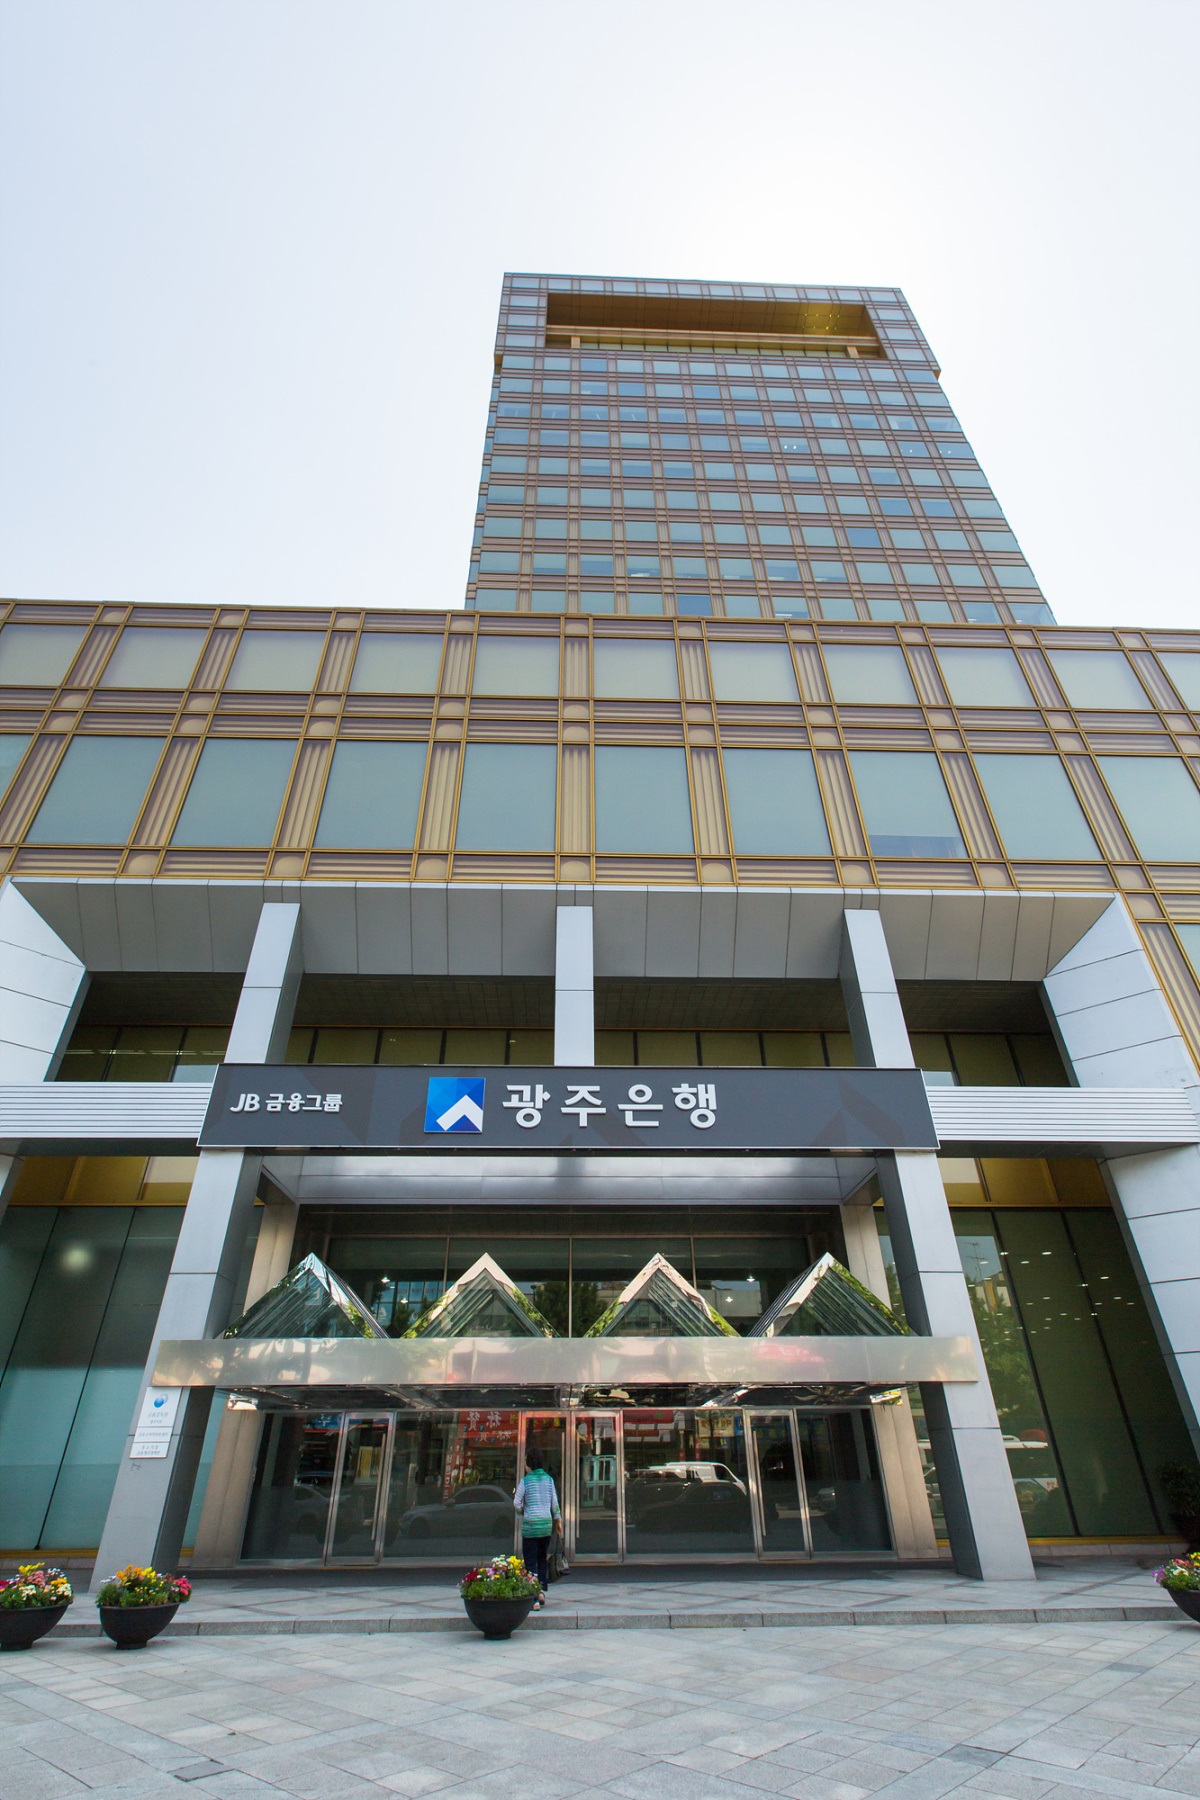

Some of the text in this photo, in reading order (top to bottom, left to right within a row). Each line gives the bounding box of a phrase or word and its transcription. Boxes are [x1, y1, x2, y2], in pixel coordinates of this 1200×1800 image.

[229, 1092, 343, 1113] JB 금융그룹
[502, 1083, 718, 1129] 광주은행
